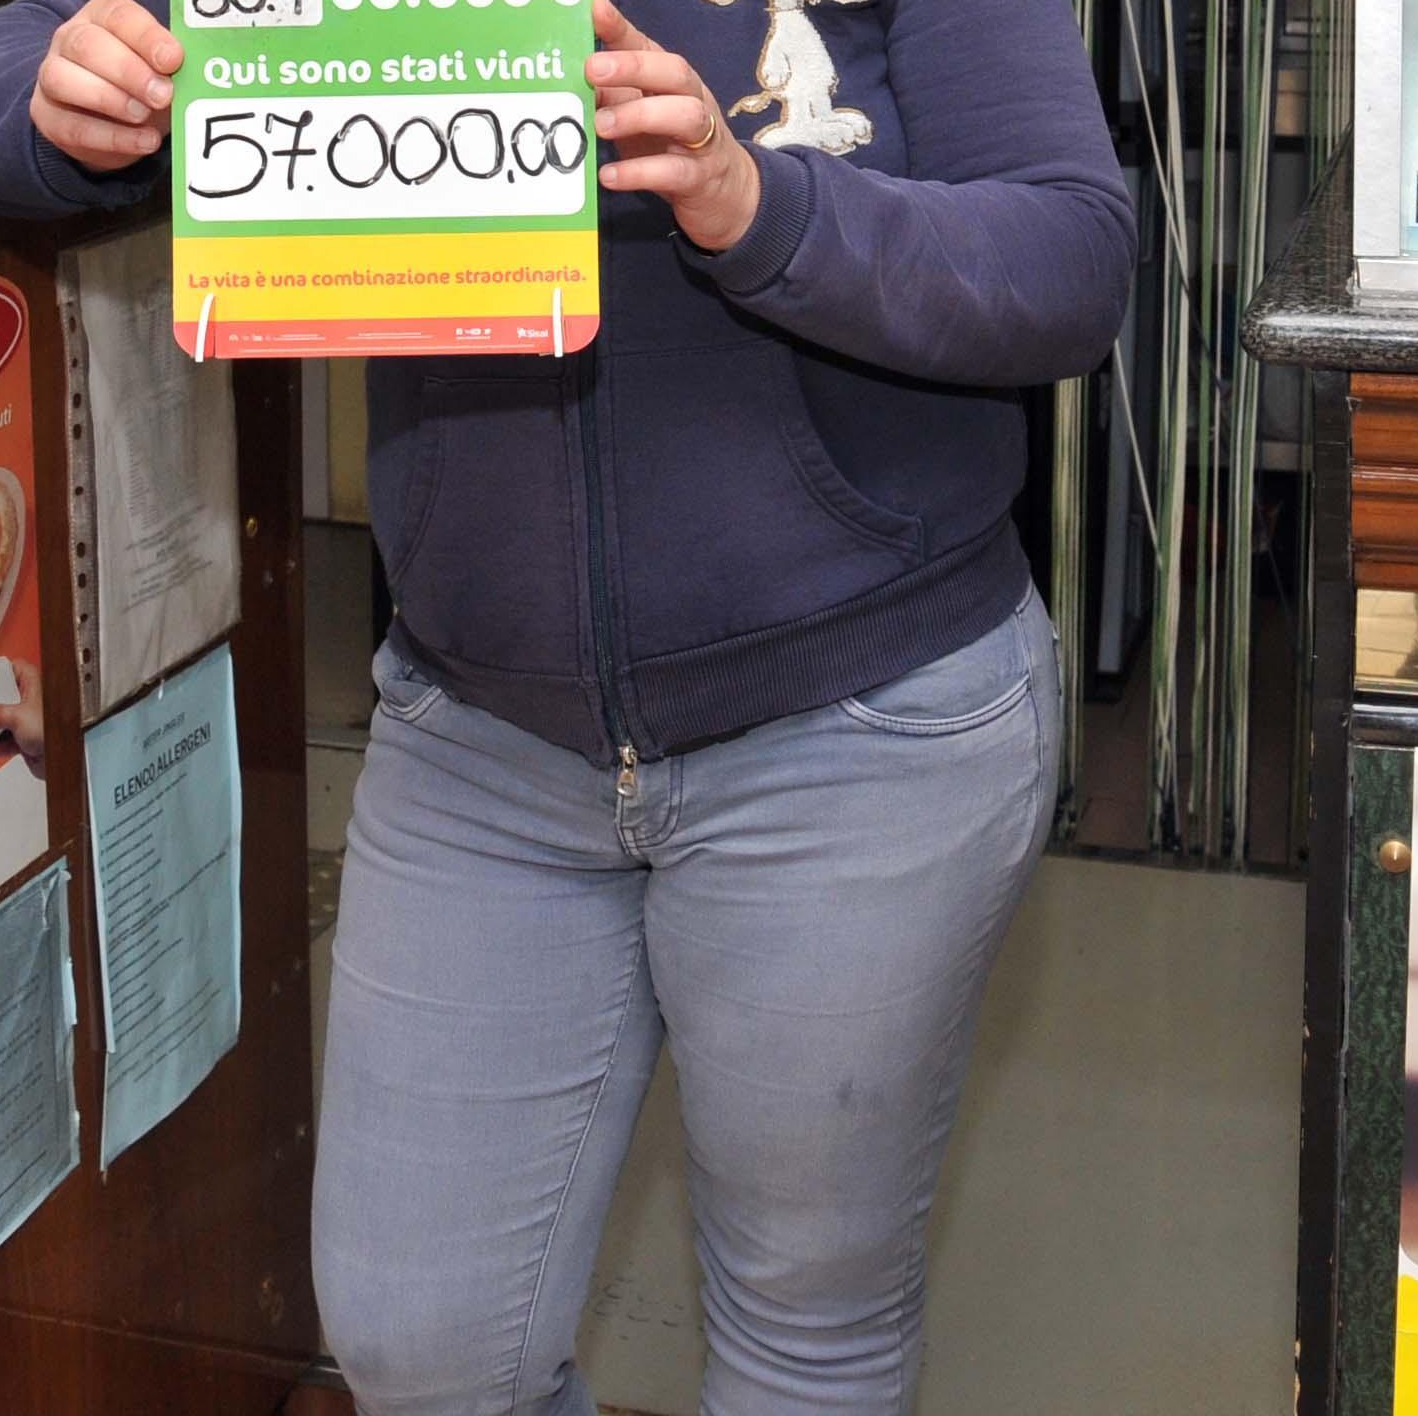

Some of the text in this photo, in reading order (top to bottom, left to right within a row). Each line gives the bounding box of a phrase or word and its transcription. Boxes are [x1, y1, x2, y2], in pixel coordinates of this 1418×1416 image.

[203, 48, 566, 89] Qui sono stati vinti
[187, 107, 589, 200] 57.000,00
[188, 266, 588, 290] La vita è una combinazione straordinaria.
[526, 327, 551, 339] Sisal
[112, 721, 212, 810] ELENCO ALLERGENI
